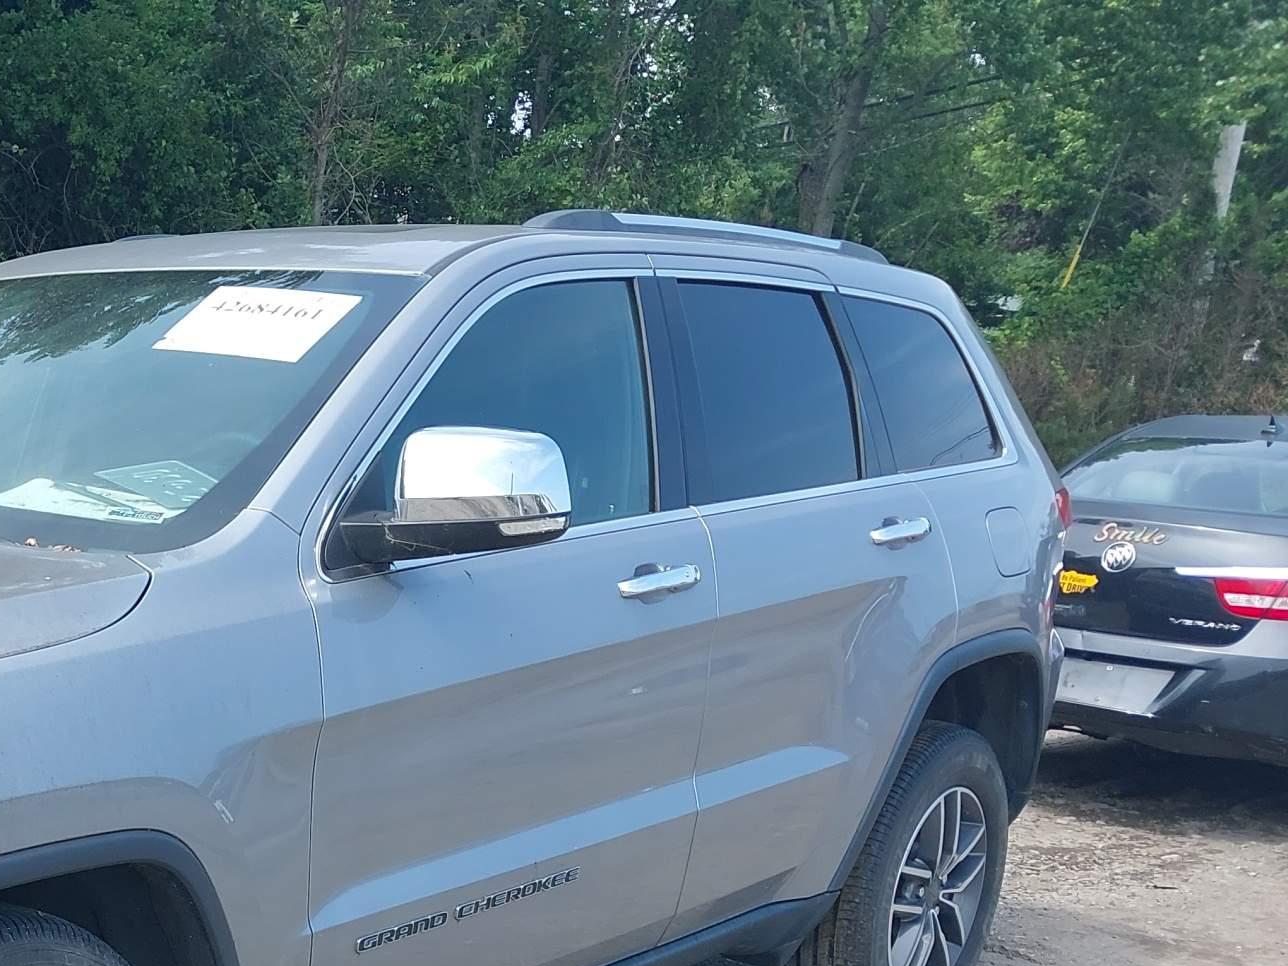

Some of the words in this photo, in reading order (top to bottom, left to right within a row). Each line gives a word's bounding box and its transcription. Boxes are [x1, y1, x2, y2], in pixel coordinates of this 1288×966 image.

[209, 301, 324, 320] 42684161
[1093, 522, 1168, 546] Smile
[1168, 617, 1241, 632] VERANO
[357, 911, 448, 953] GRAND
[456, 866, 581, 921] CHEROKEE
